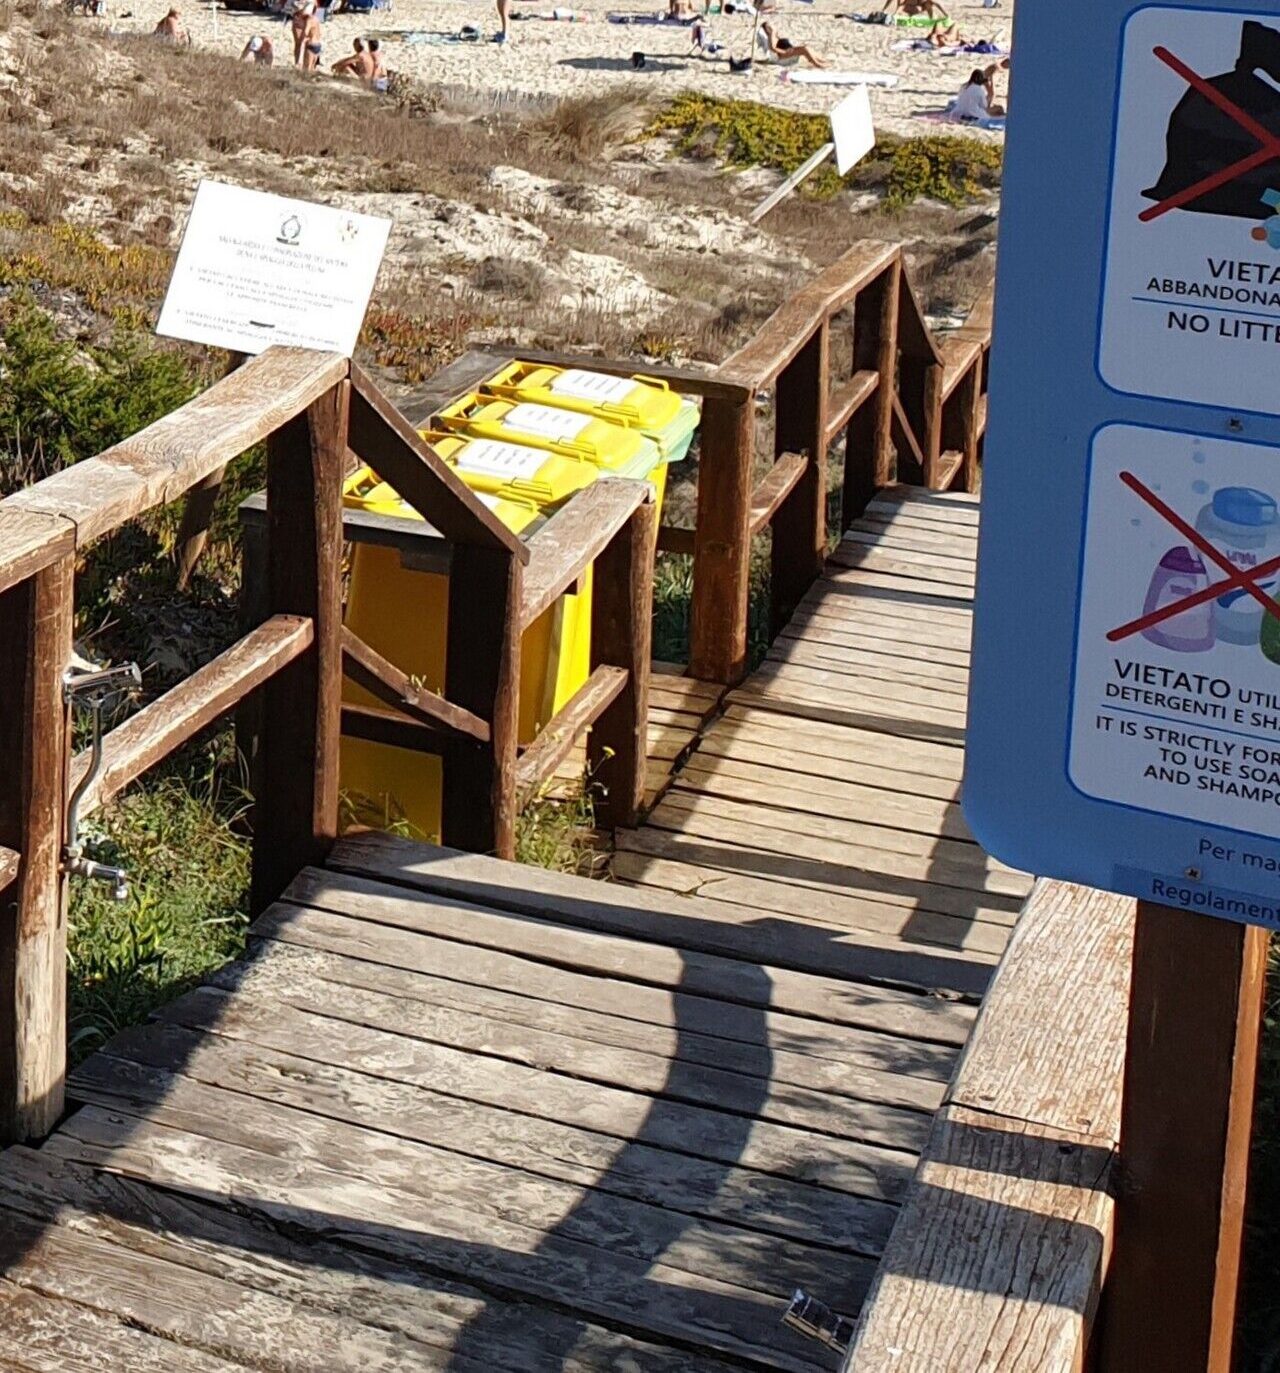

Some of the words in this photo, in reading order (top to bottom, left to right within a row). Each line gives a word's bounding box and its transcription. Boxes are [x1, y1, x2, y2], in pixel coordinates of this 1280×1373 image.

[1147, 277, 1280, 308] ABBANDONA
[1168, 311, 1210, 333] NO
[1114, 659, 1231, 699] VIETATO
[1106, 683, 1226, 719] DETERGENTI
[1234, 709, 1244, 724] E
[1250, 712, 1280, 732] SH
[1096, 715, 1114, 731] IT
[1120, 721, 1137, 736] IS
[1144, 726, 1236, 757] STRICTLY
[1242, 745, 1280, 767] FOR
[1143, 764, 1190, 786] AND
[1159, 747, 1187, 766] TO
[1194, 755, 1232, 776] USE
[1238, 765, 1280, 788] SOA
[1199, 838, 1236, 862] Per
[1243, 851, 1280, 878] ma
